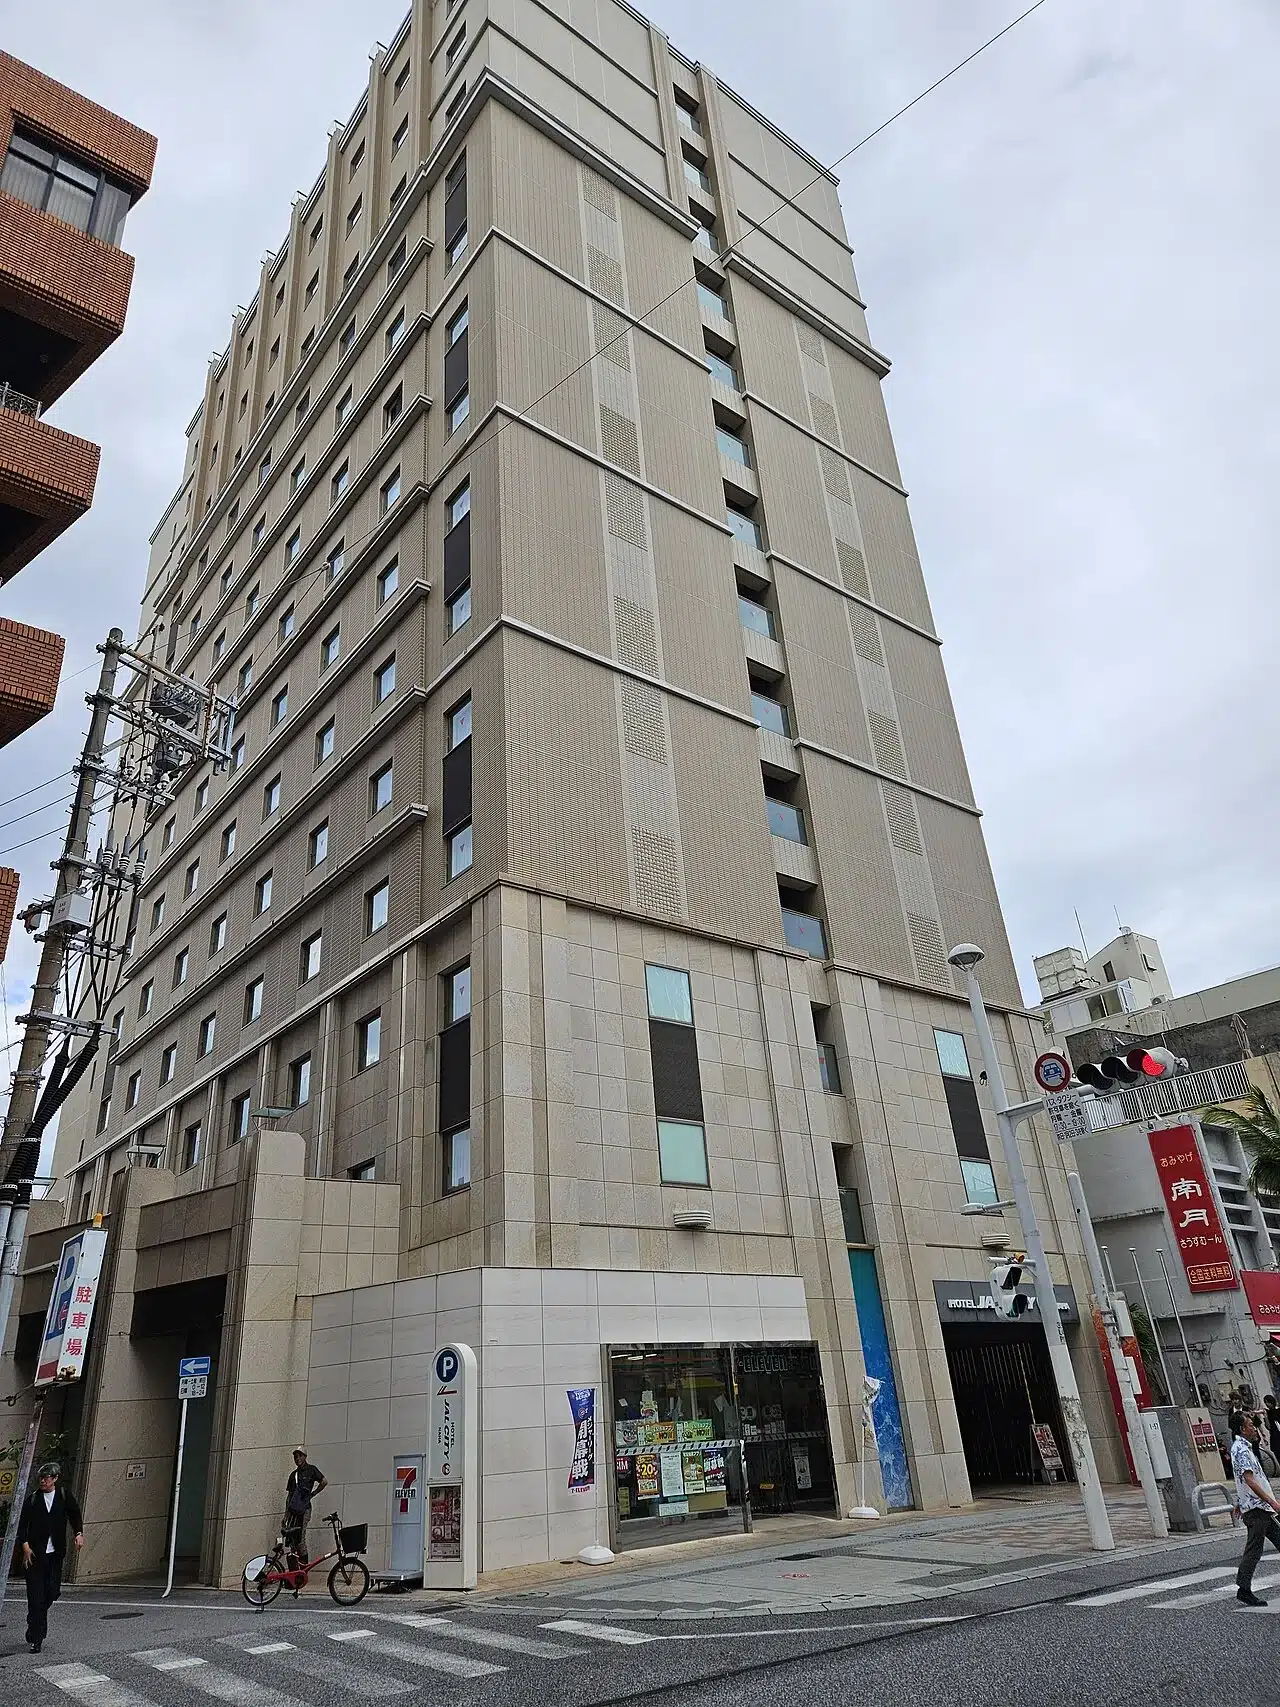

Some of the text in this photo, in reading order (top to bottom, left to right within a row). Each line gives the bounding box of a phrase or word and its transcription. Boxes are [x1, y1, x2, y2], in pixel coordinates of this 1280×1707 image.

[1160, 1152, 1193, 1167] おみやげ
[1171, 1178, 1209, 1228] 南月
[1180, 1234, 1222, 1249] さうすむーん
[1190, 1264, 1231, 1281] 全国送料無料
[948, 1300, 976, 1308] HOTEL
[67, 1286, 92, 1355] 駐車場
[442, 1356, 454, 1378] P
